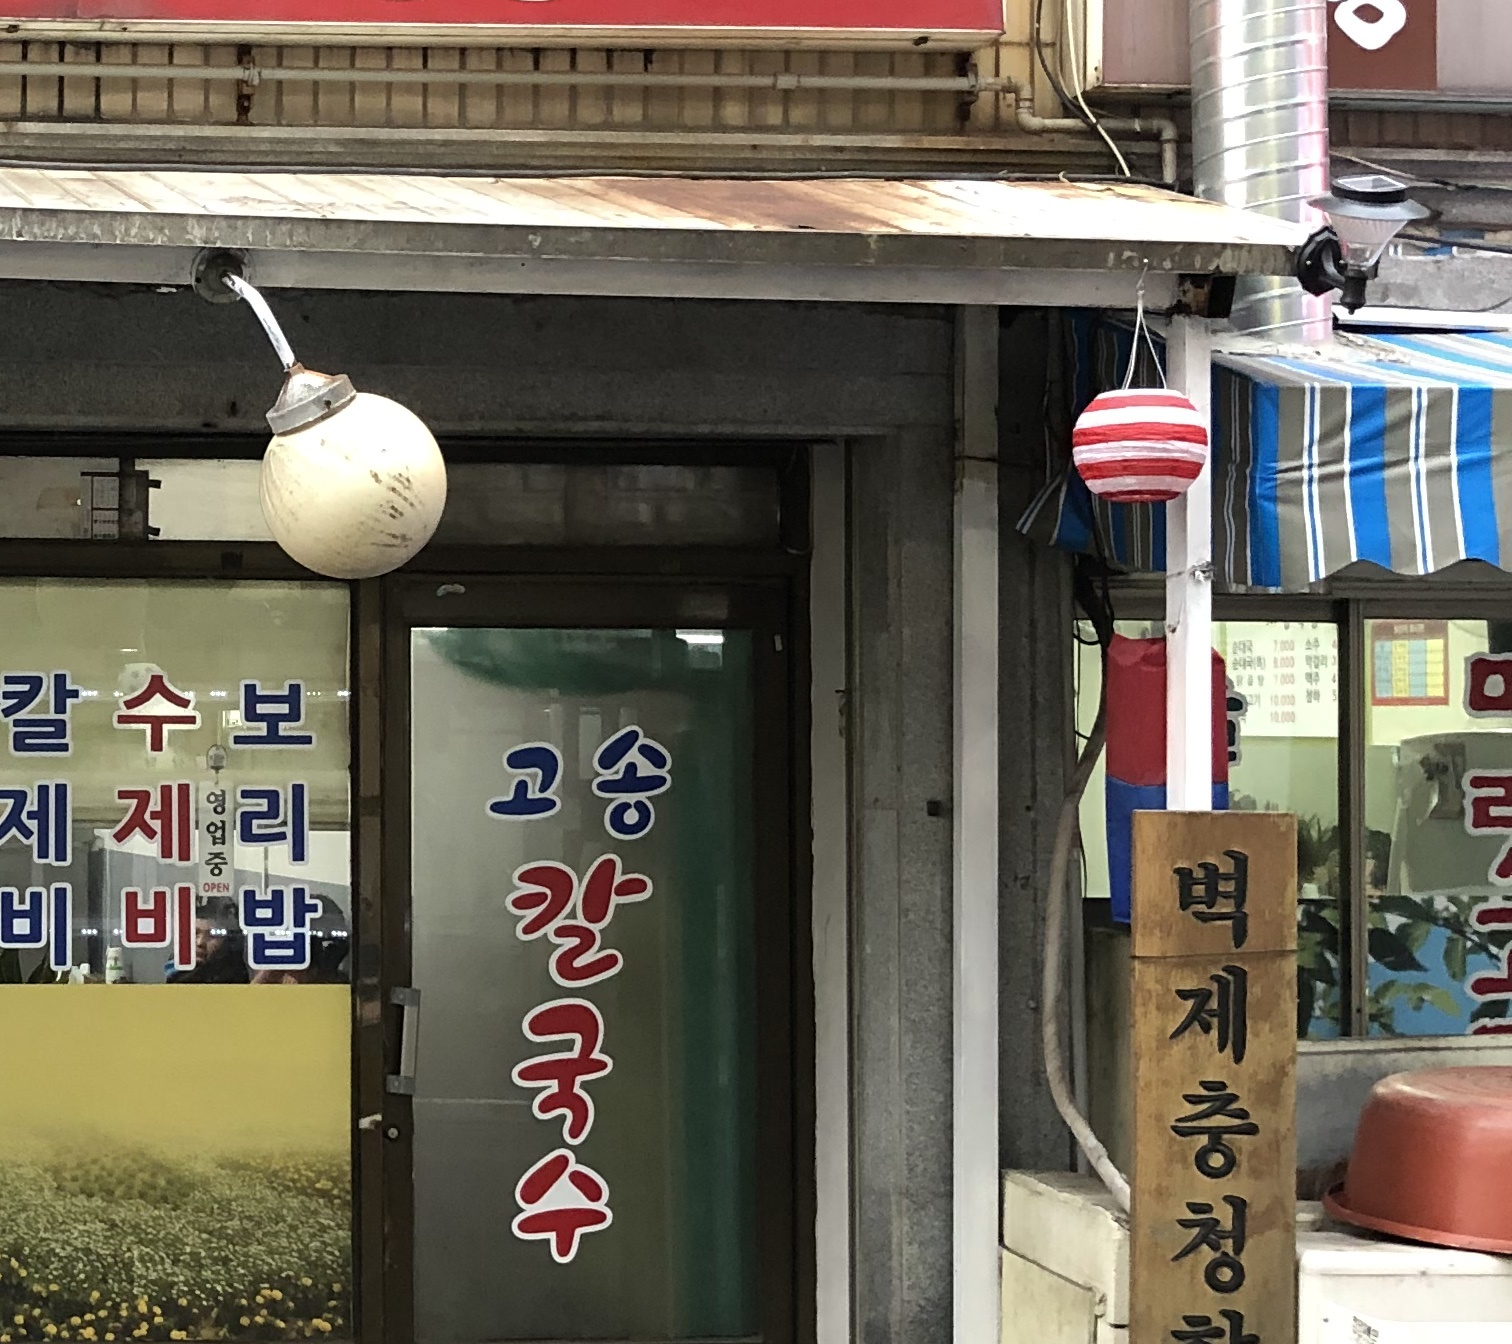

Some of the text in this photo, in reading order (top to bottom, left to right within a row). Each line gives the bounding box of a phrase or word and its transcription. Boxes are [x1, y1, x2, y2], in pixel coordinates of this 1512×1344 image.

[111, 673, 198, 970] 수제비
[205, 788, 229, 877] 영업중
[232, 682, 322, 966] 보리밥
[486, 726, 672, 839] 고송
[203, 882, 230, 893] OPEN
[508, 854, 652, 1260] 칼국수
